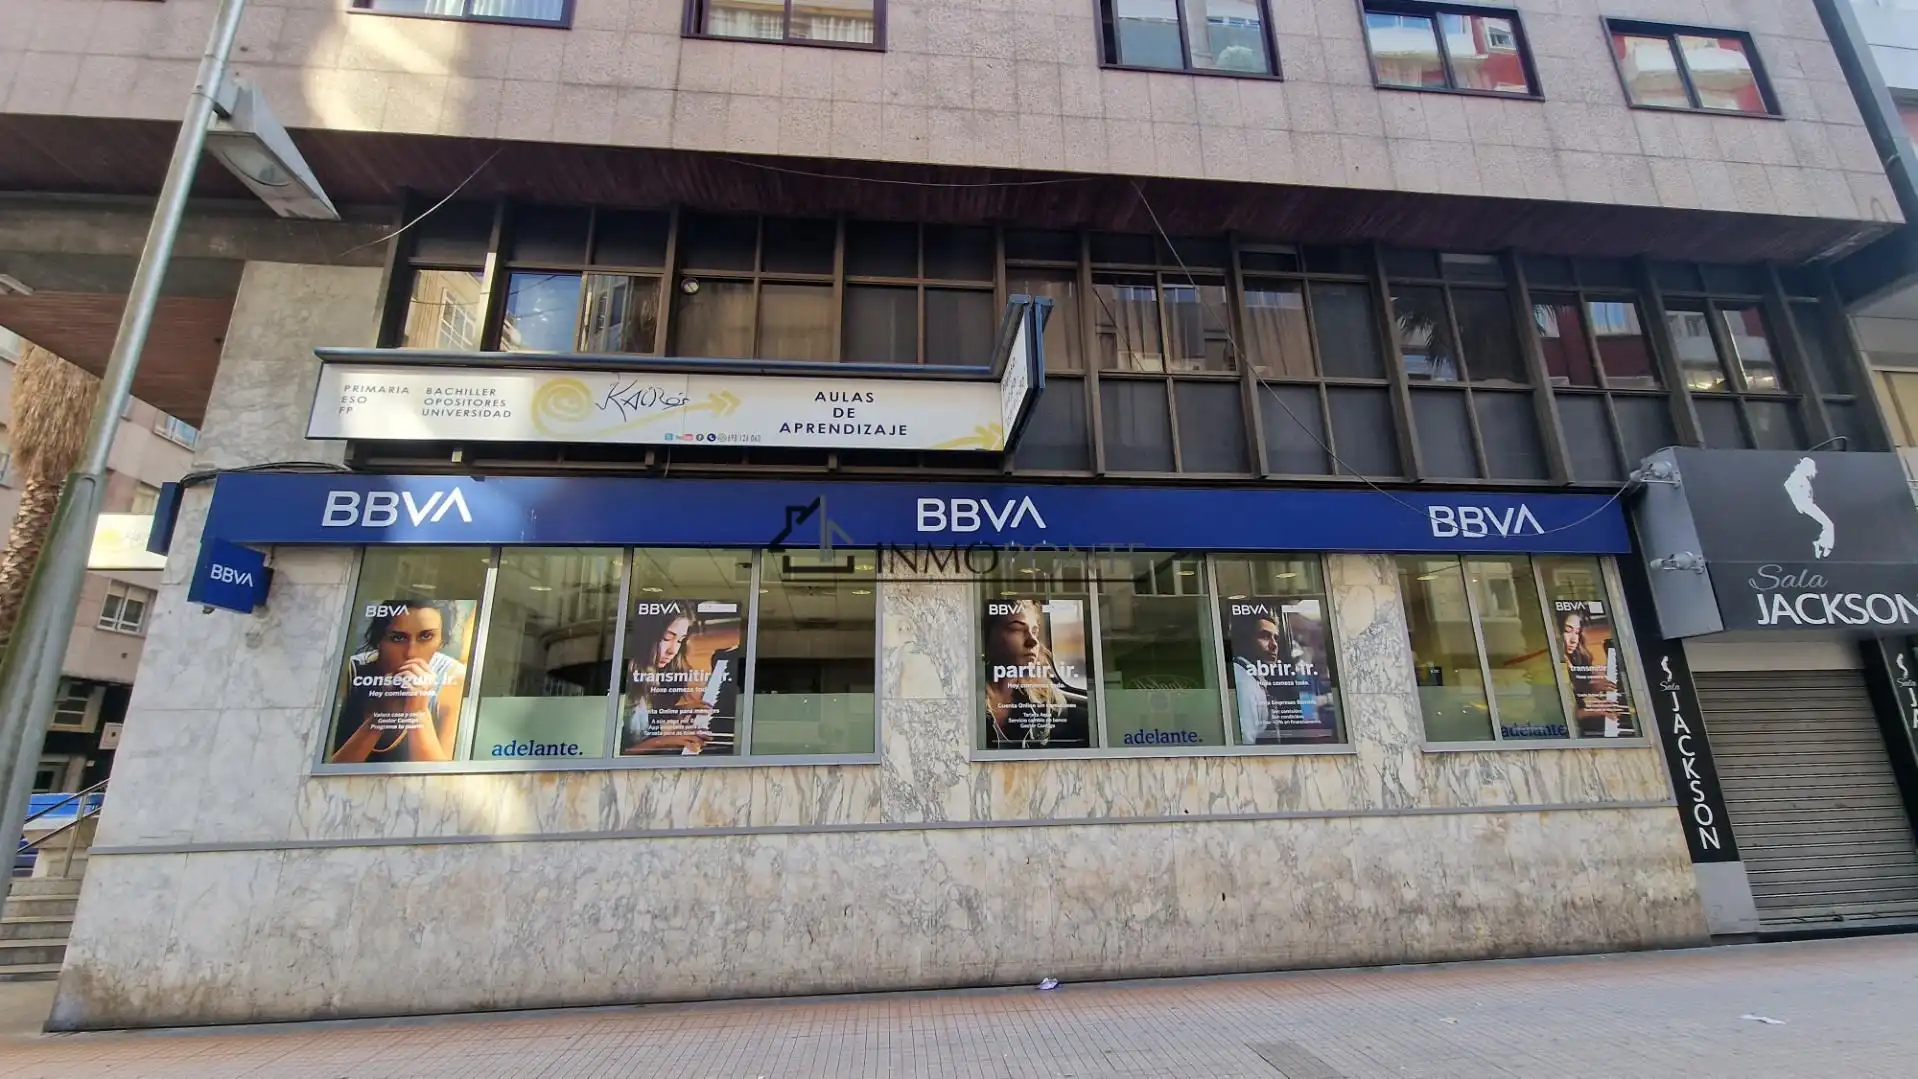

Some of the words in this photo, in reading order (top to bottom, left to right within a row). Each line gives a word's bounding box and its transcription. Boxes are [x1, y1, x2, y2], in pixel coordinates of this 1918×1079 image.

[343, 384, 411, 395] PRIMARIA
[425, 387, 497, 397] BACHILLER
[340, 396, 368, 405] ESO
[424, 398, 507, 408] OPOSITORES
[814, 391, 875, 404] AULAS
[338, 406, 354, 416] FP
[421, 409, 512, 419] UNIVERSIDAD
[832, 407, 856, 419] DE
[779, 422, 909, 437] APRENDIZAJE
[321, 486, 473, 527] BBVA
[916, 495, 1047, 532] BBVA
[1427, 503, 1545, 538] BBVA
[210, 563, 254, 588] BBVA
[1748, 563, 1828, 592] Sala
[365, 604, 410, 618] BBVA
[638, 602, 681, 615] BBVA
[988, 604, 1027, 616] BBVA
[1231, 604, 1269, 616] BBVA
[1555, 601, 1587, 611] BBVA
[1756, 593, 1918, 625] JACKSON
[993, 661, 1055, 683] partir.
[1246, 660, 1296, 677] abrir.
[1124, 728, 1203, 745] adelante.
[491, 740, 584, 757] adelante.
[1671, 691, 1721, 850] JACKSON
